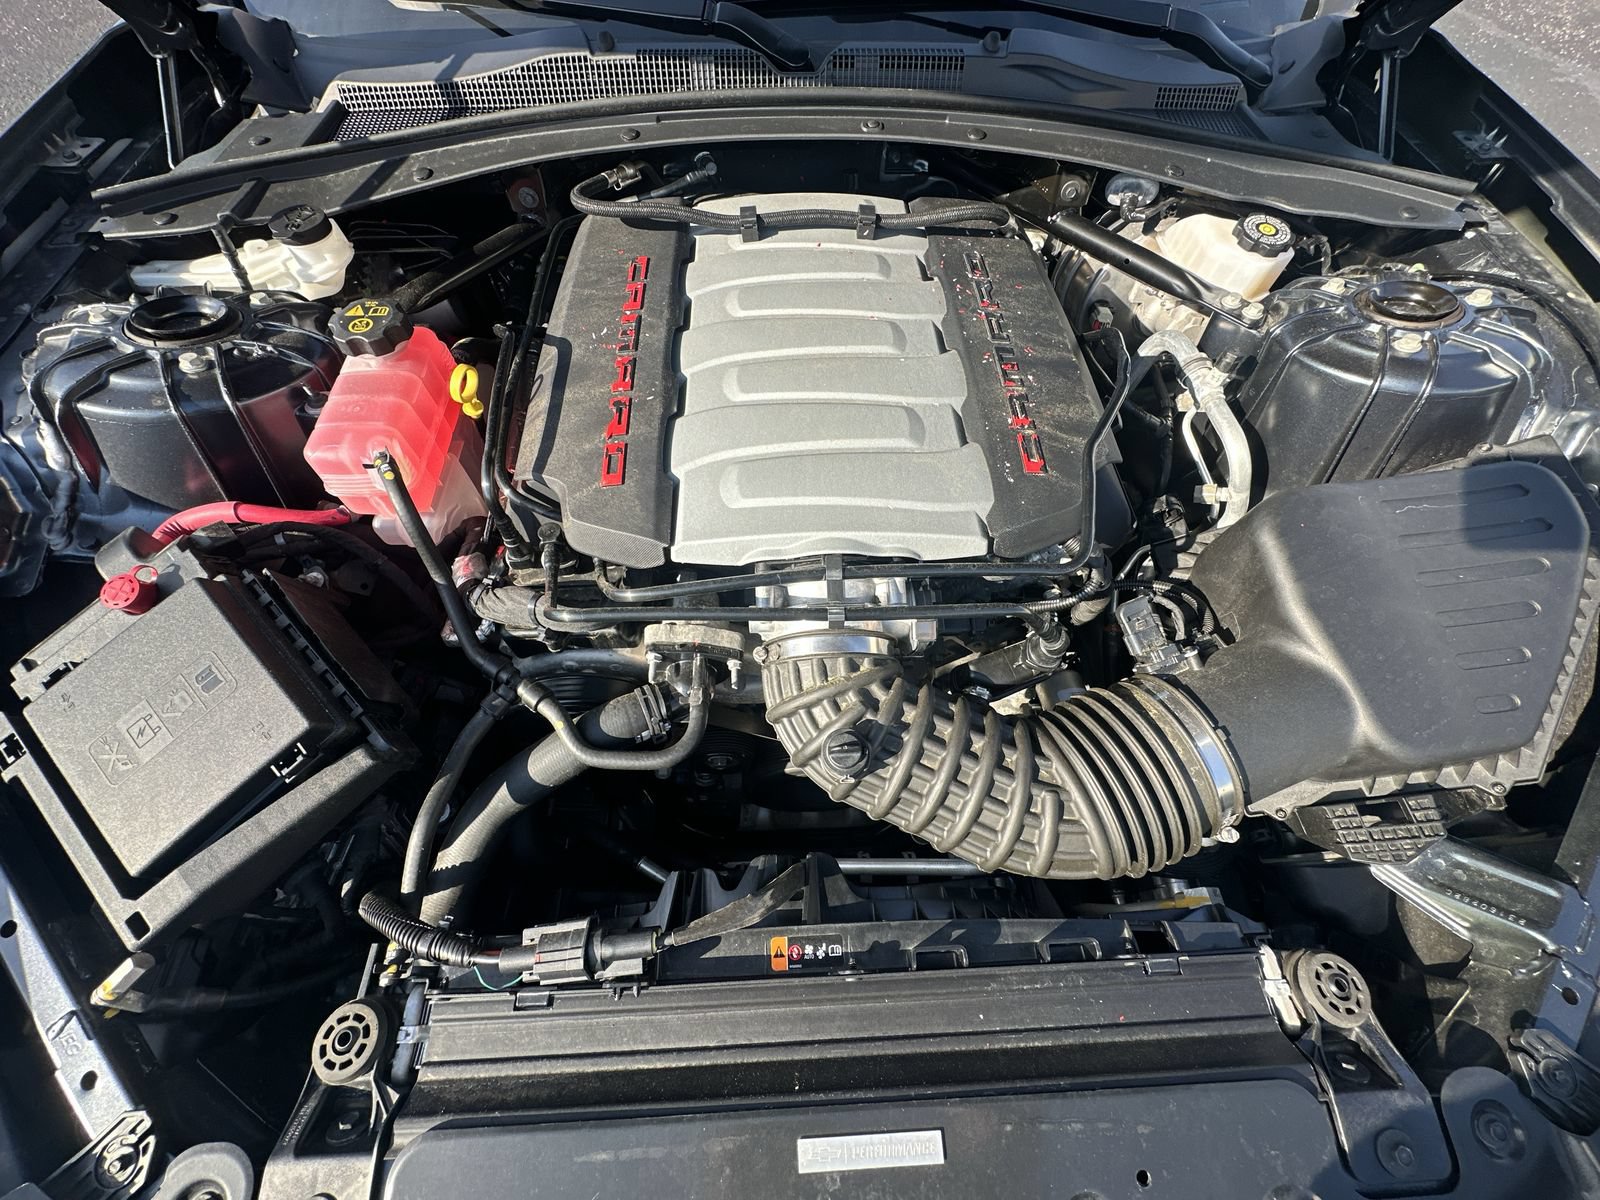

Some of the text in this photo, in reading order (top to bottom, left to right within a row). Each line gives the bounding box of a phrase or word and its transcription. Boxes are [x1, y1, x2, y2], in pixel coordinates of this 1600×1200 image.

[600, 255, 650, 487] CAMARO
[963, 250, 1049, 475] CAMARO
[851, 1142, 936, 1160] PERFORMANCE
